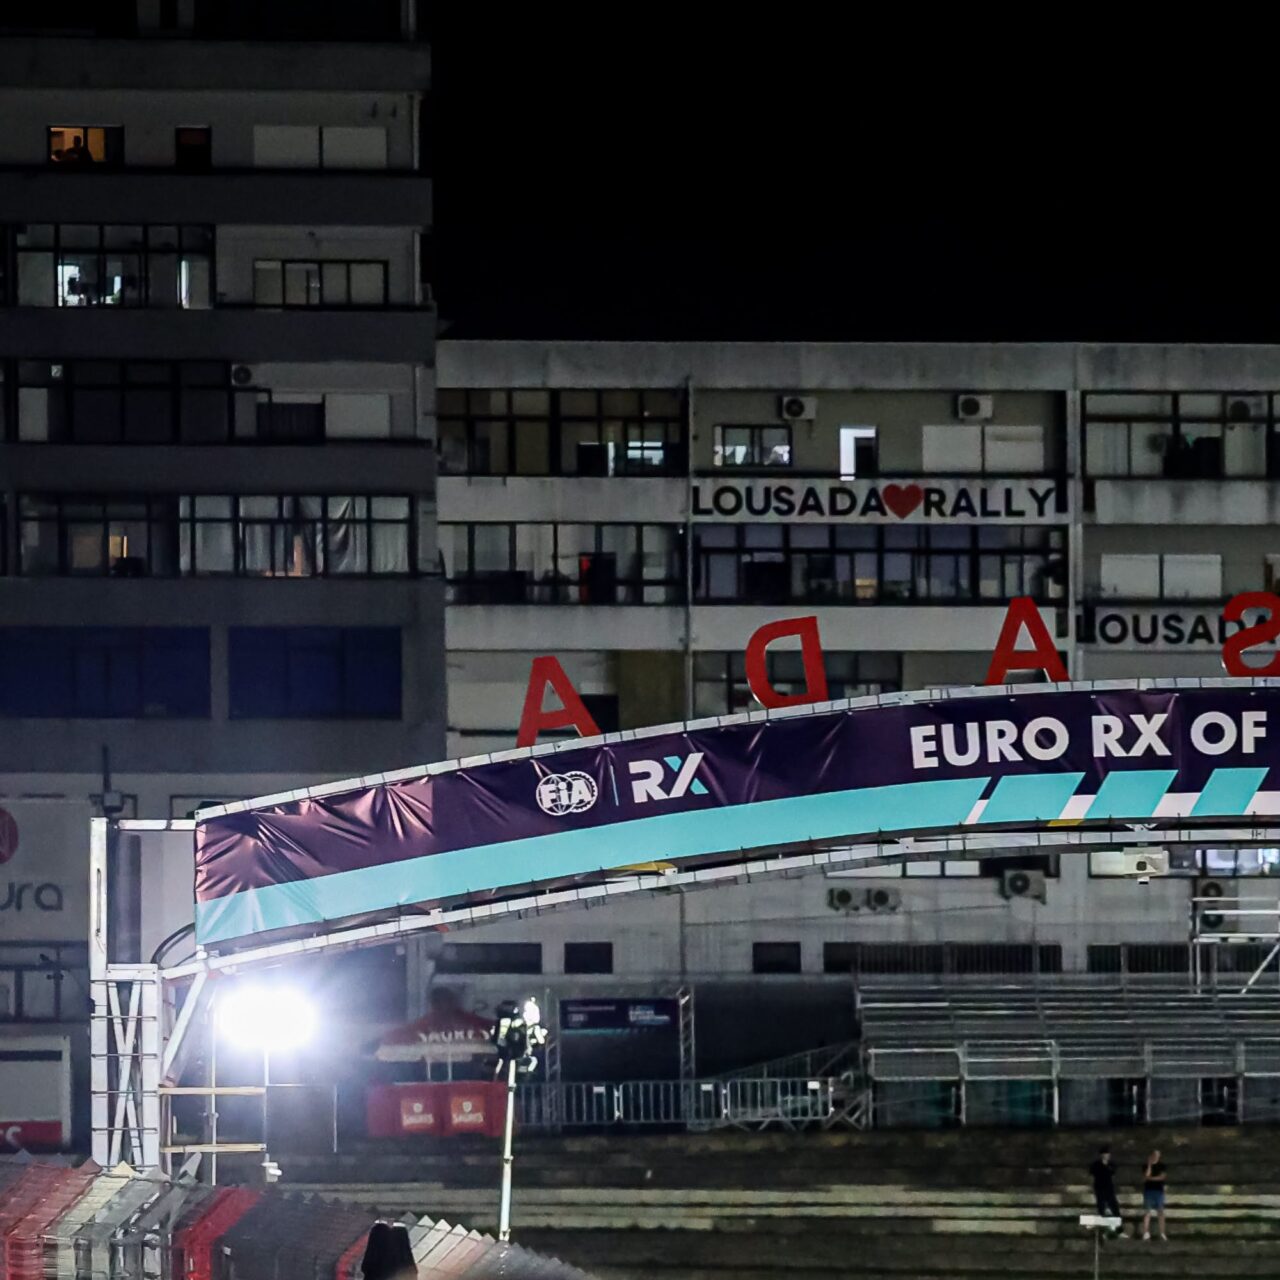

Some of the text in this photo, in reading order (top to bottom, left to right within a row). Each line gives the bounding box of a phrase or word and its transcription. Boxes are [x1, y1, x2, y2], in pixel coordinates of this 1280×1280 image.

[691, 485, 1056, 518] LOUSADA RALLY
[910, 715, 1070, 769] EURO
[1092, 713, 1177, 757] RX
[1190, 710, 1269, 756] OF
[628, 752, 709, 803] RX
